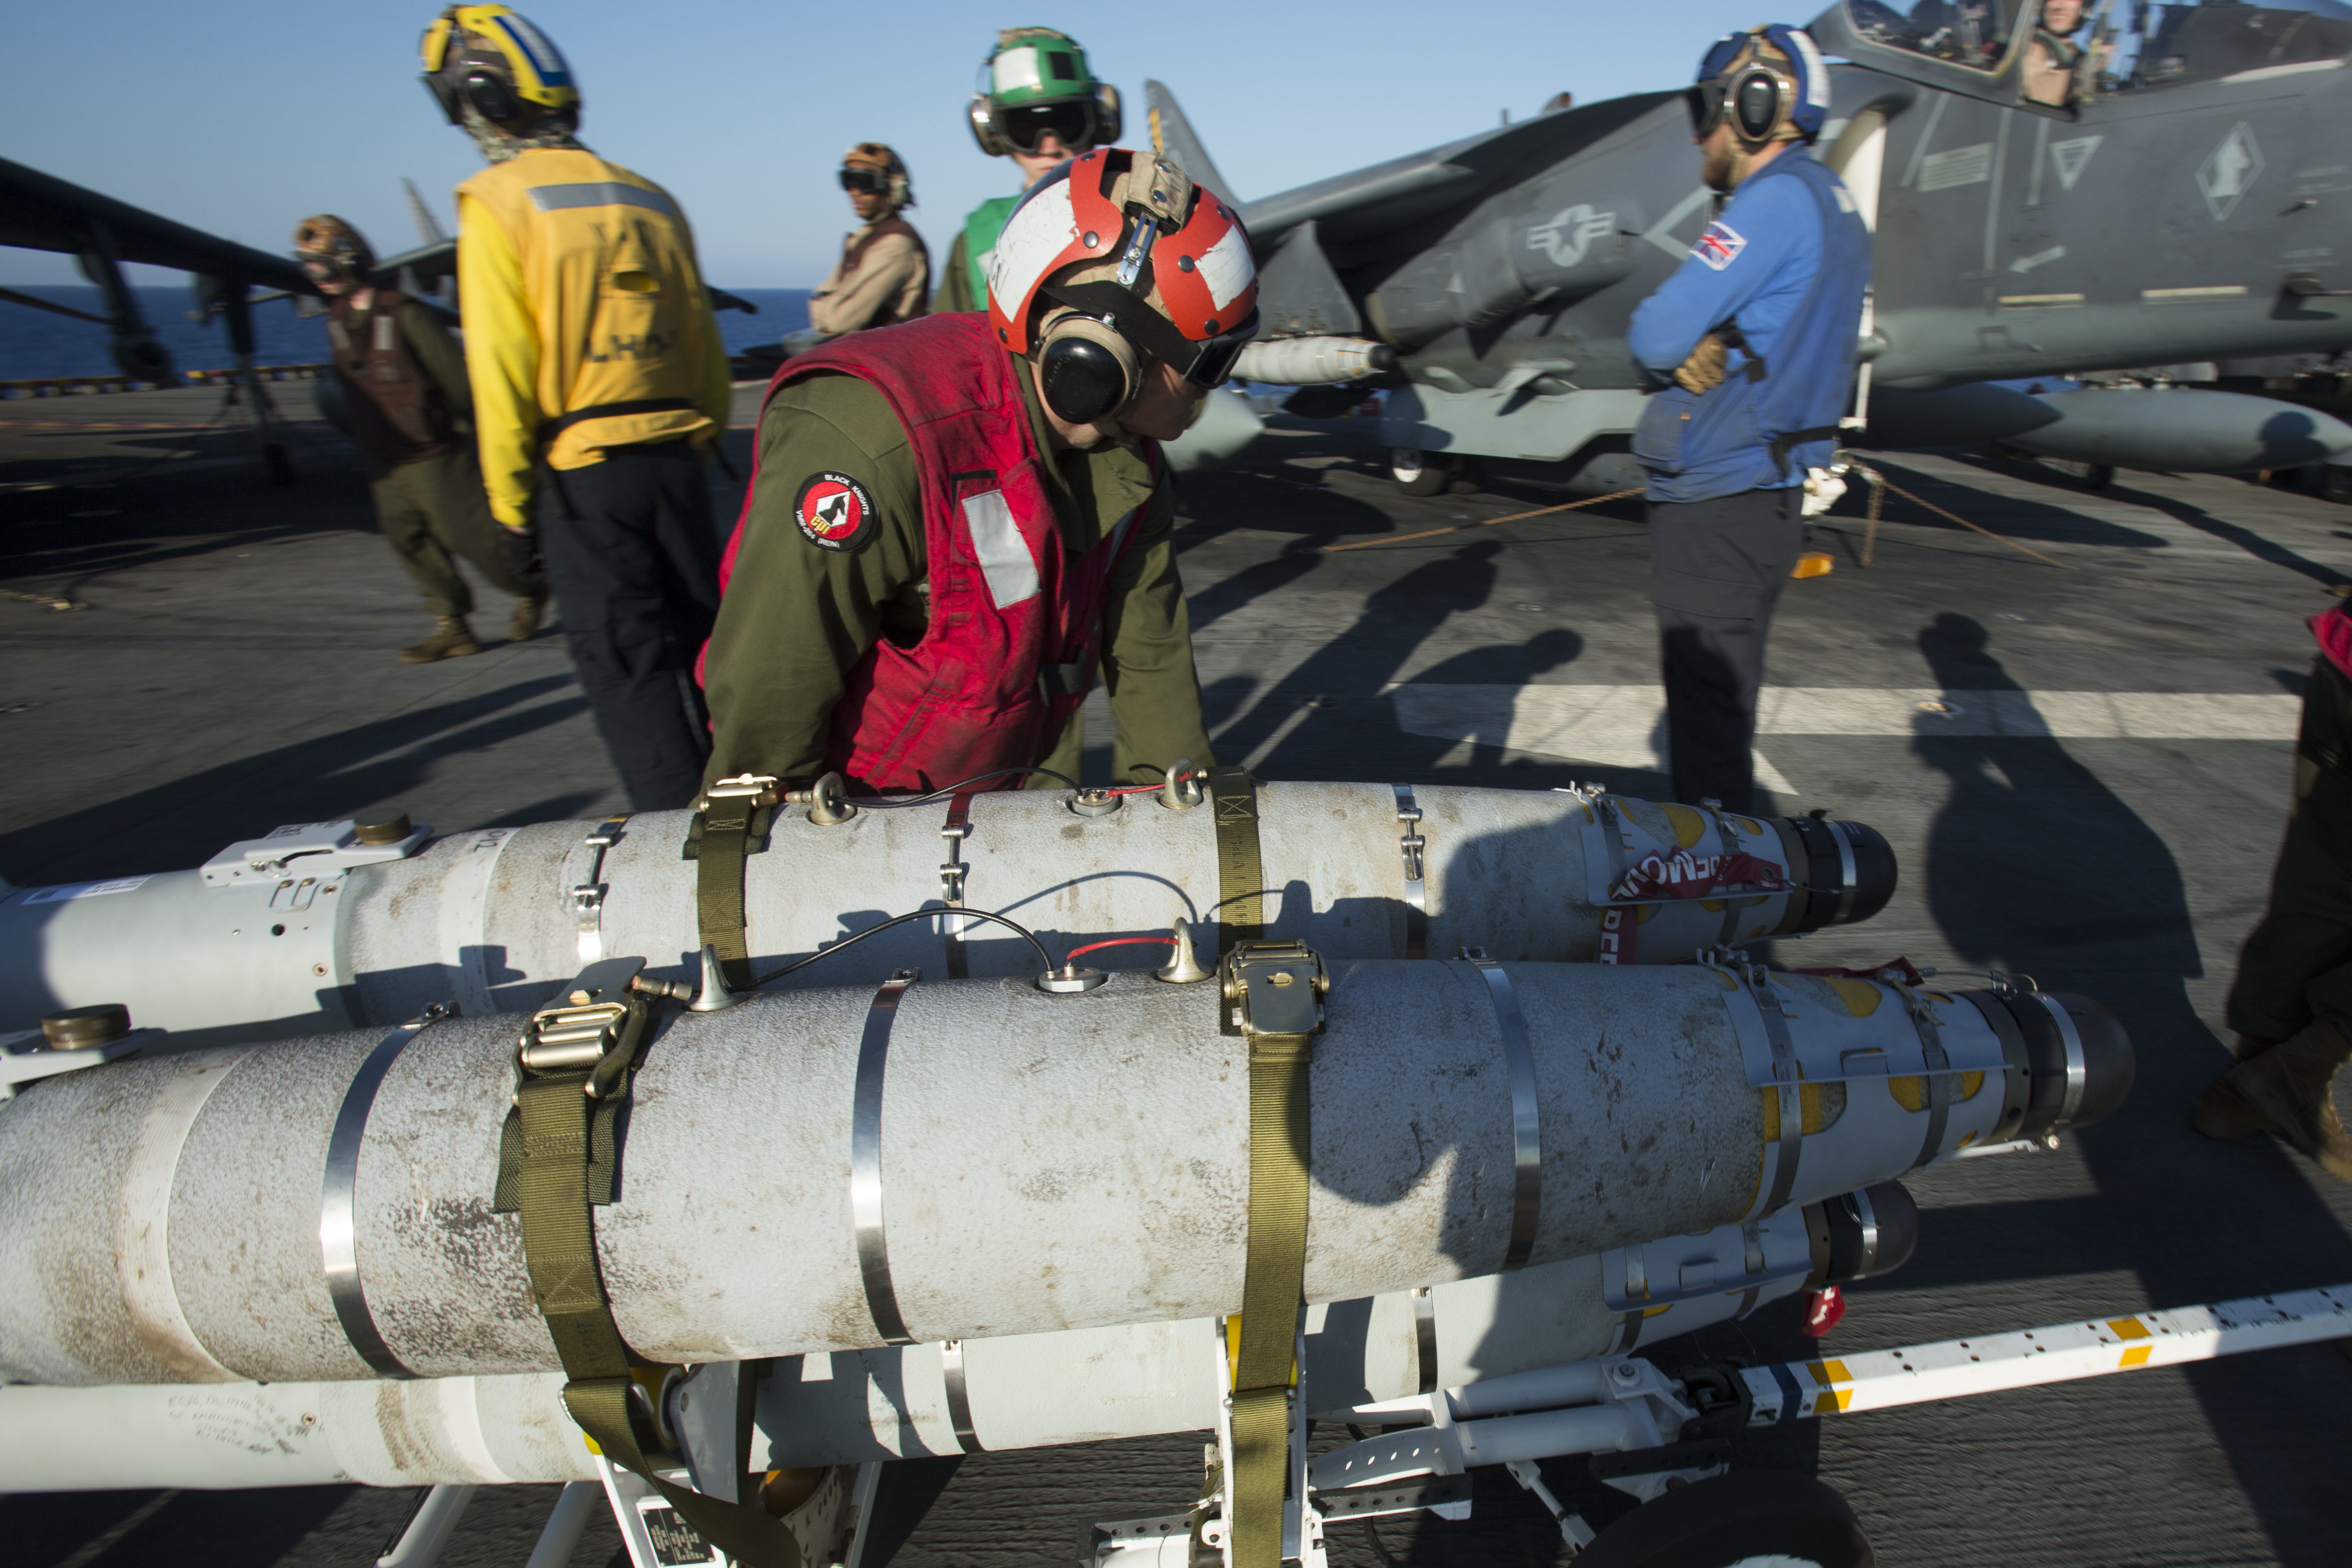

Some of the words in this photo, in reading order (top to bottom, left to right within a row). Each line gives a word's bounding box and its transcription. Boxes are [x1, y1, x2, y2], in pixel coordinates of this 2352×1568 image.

[824, 474, 850, 486] BLACK
[851, 486, 869, 516] KNIGHTS
[810, 515, 831, 535] CDI
